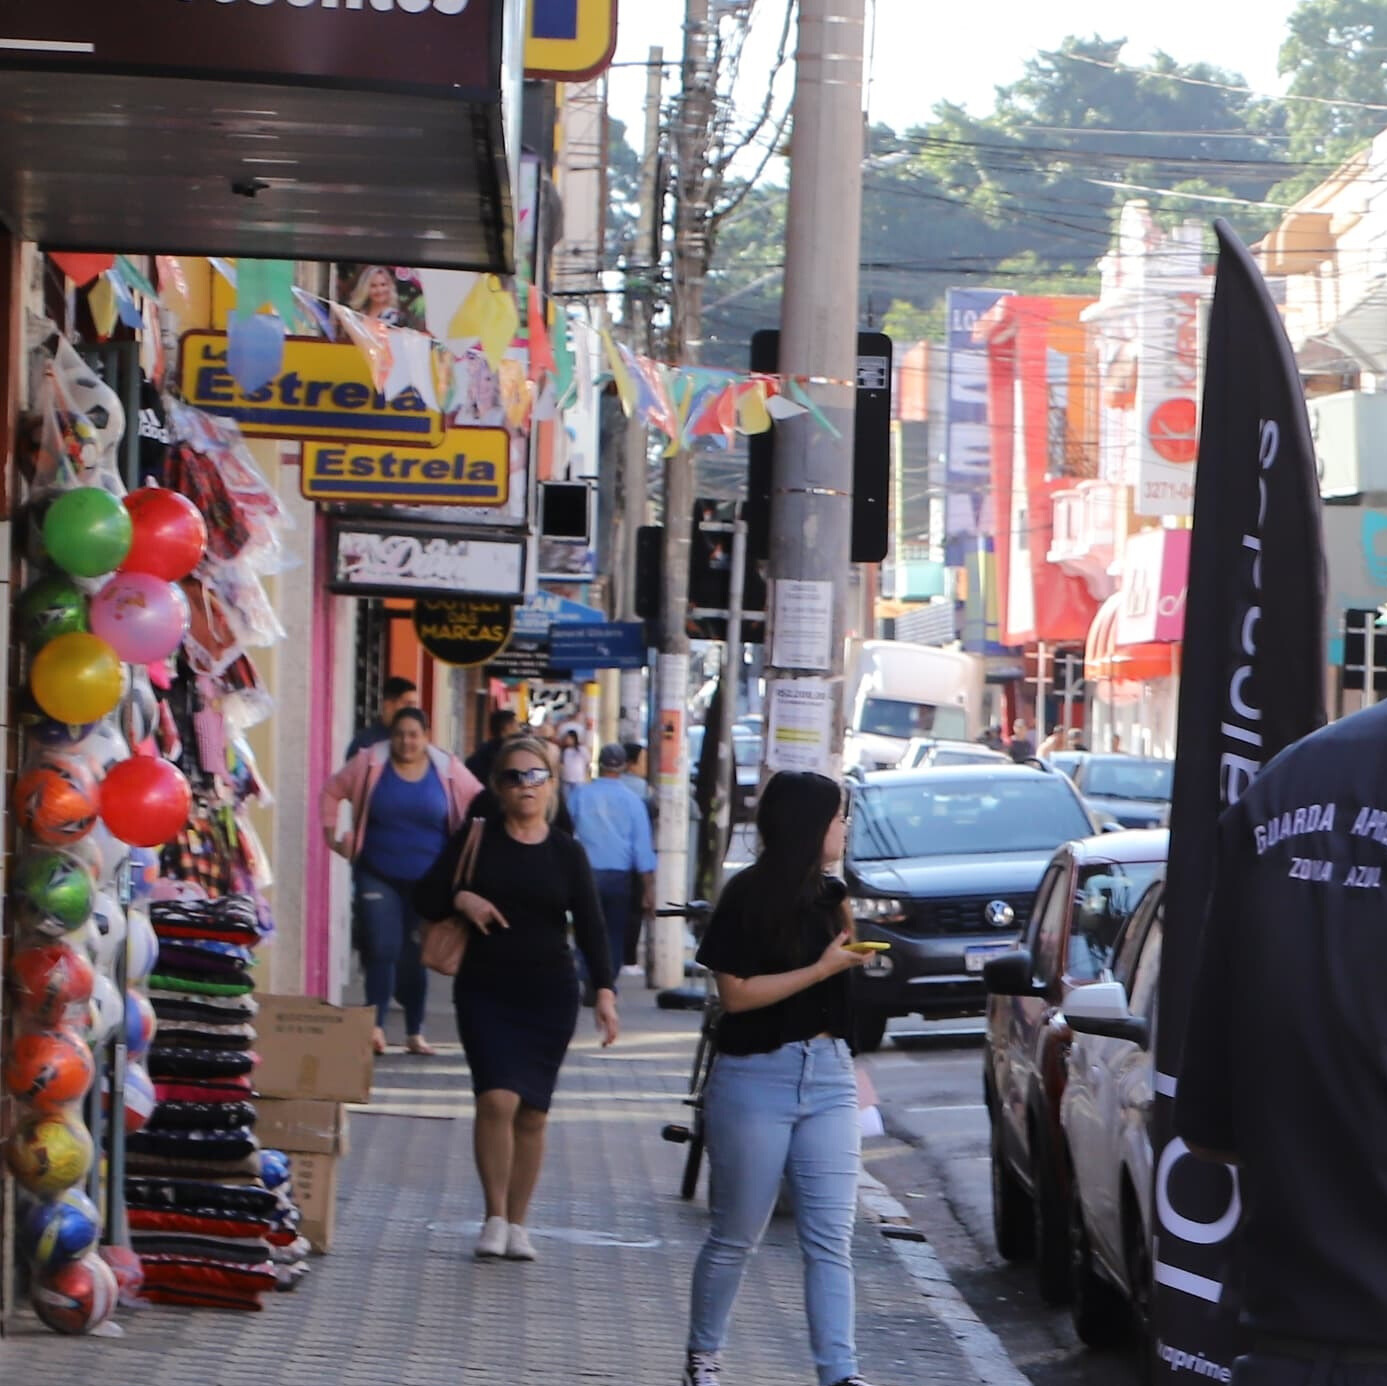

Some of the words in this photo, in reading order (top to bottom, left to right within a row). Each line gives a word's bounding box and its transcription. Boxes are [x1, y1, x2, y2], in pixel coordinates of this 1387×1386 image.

[196, 366, 426, 411] Etrea
[314, 449, 495, 481] Estrela
[421, 623, 505, 641] MARCAS
[1254, 803, 1336, 855] GUARDA
[1288, 857, 1333, 881] ZONA
[1343, 866, 1382, 887] AZUL
